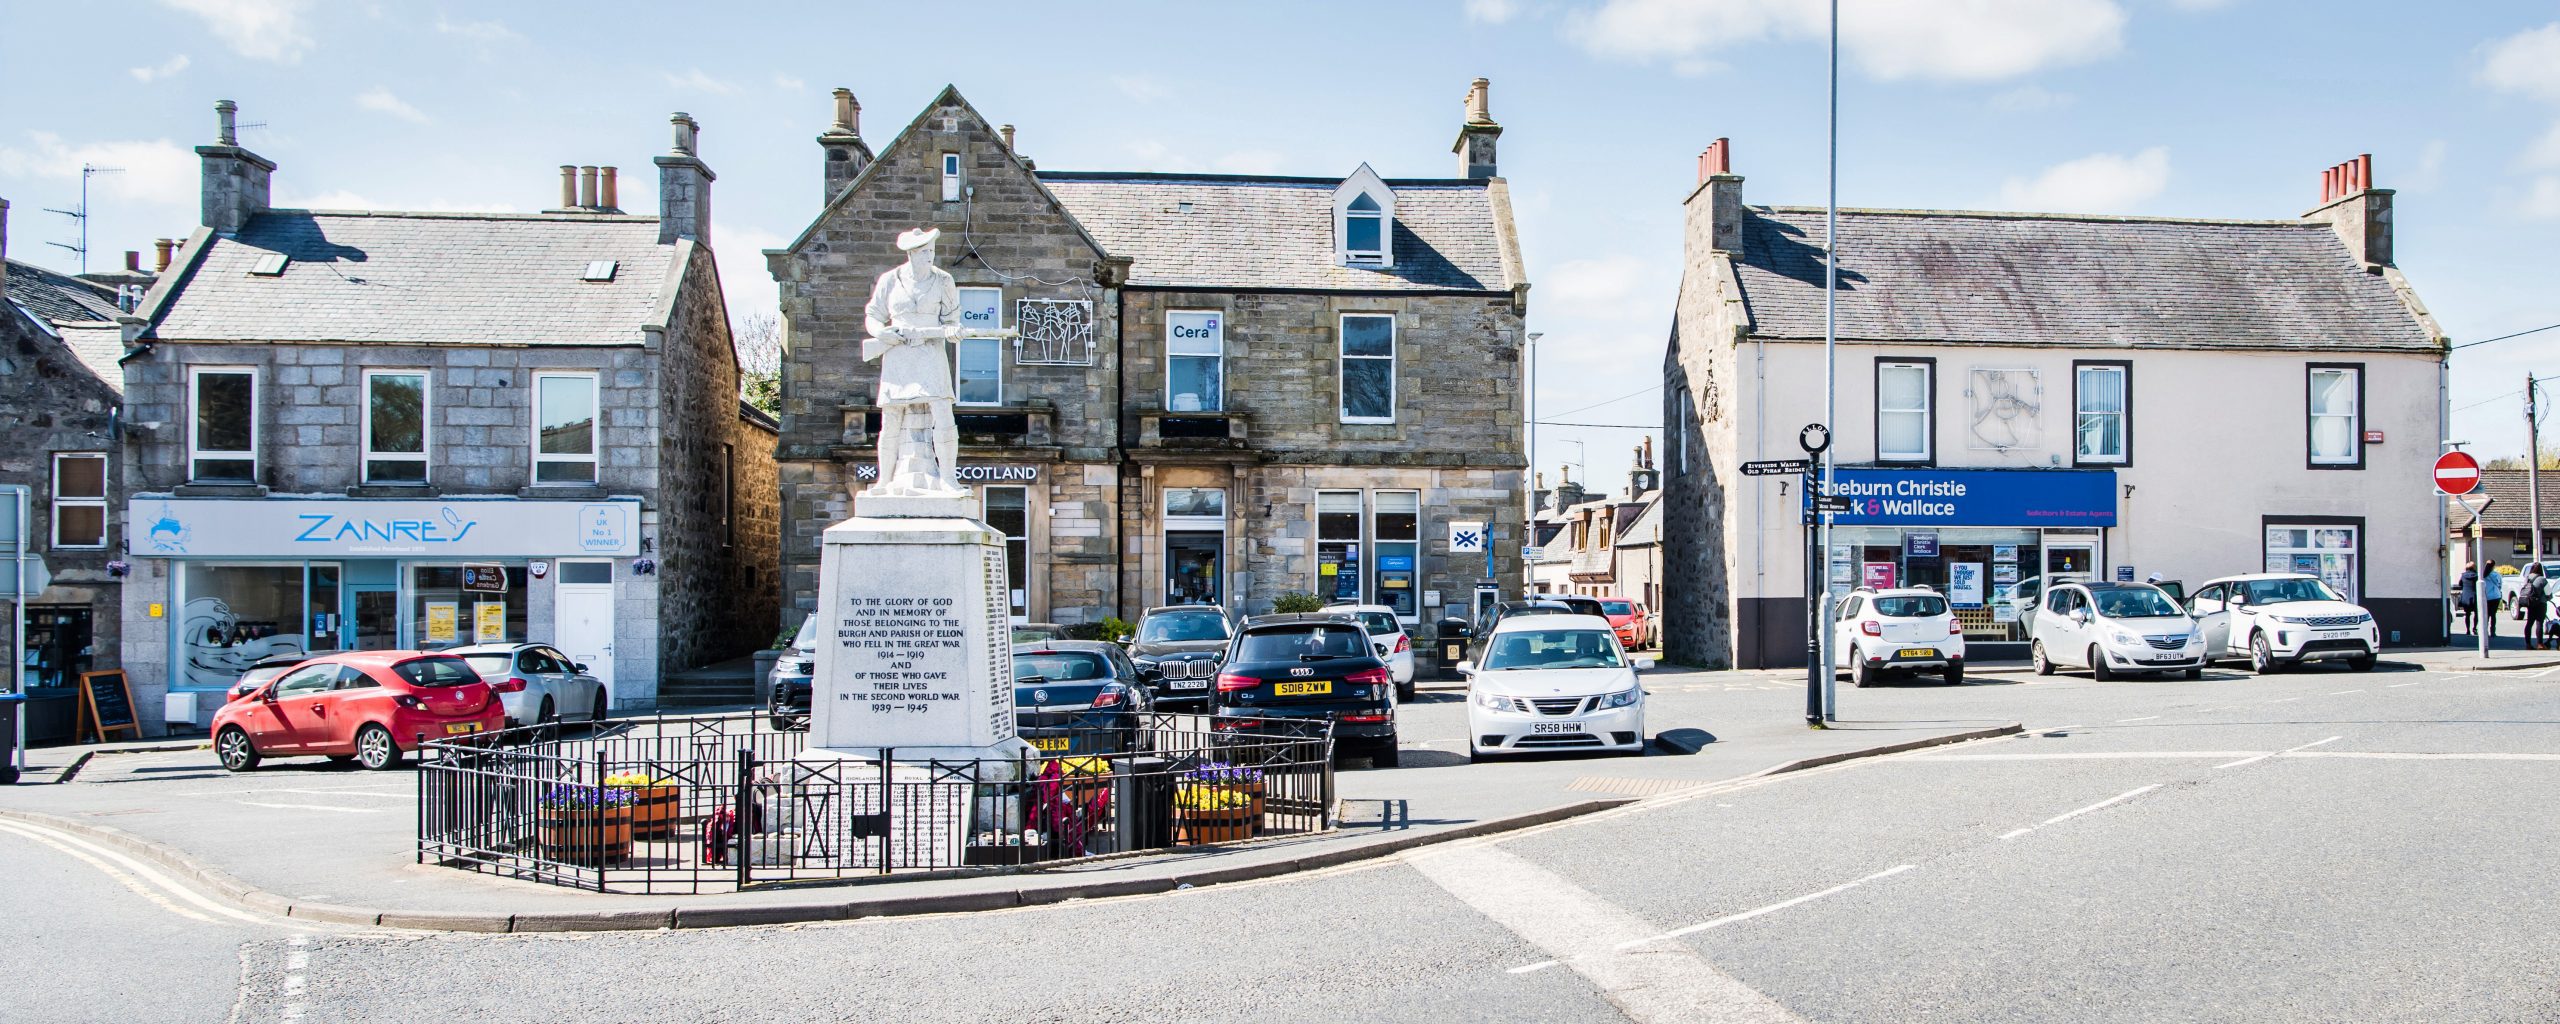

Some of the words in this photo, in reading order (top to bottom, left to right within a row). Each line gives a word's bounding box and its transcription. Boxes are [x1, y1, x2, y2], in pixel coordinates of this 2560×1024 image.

[964, 311, 989, 321] Cera
[1174, 326, 1209, 338] Cera
[1802, 424, 1828, 435] ELLON
[955, 466, 1037, 480] SCOTLAND
[1897, 480, 1966, 496] Christie
[1867, 499, 1880, 516] &
[1882, 499, 1955, 515] Wallace
[2474, 528, 2481, 537] H
[851, 598, 862, 606] TO
[866, 598, 881, 606] THE
[885, 598, 914, 606] GLORY
[917, 598, 929, 606] OF
[933, 598, 953, 606] GOD
[856, 608, 876, 616] AND
[880, 608, 890, 616] IN
[893, 608, 933, 616] MEMORY
[936, 608, 947, 616] OF
[843, 619, 871, 627] THOSE
[875, 619, 926, 627] BELONGING
[929, 619, 940, 627] TO
[943, 619, 959, 627] THE
[838, 630, 867, 638] BURGH
[869, 630, 888, 638] AND
[890, 630, 921, 638] PARISH
[923, 630, 934, 638] OF
[936, 630, 964, 638] ELLON
[842, 640, 861, 648] WHO
[864, 640, 882, 648] FELL
[885, 640, 894, 648] IN
[896, 640, 912, 648] THE
[914, 640, 940, 648] GREAT
[942, 640, 960, 648] WAR
[877, 651, 894, 659] 1914
[906, 651, 925, 659] 1919
[890, 661, 912, 669] AND
[855, 672, 867, 680] OF
[869, 672, 899, 680] THOSE
[902, 672, 921, 680] WHO
[923, 672, 947, 680] GAVE
[873, 682, 900, 690] THEIR
[902, 682, 928, 690] LIVES
[1281, 683, 1304, 693] SD18
[1306, 682, 1326, 692] ZWW
[840, 693, 849, 701] IN
[852, 693, 868, 701] THE
[870, 693, 906, 701] SECOND
[908, 693, 939, 701] WORLD
[941, 693, 960, 701] WAR
[872, 704, 892, 713] 1939
[907, 704, 928, 713] 1945
[1534, 723, 1560, 733] SR58
[1562, 722, 1582, 732] HHW
